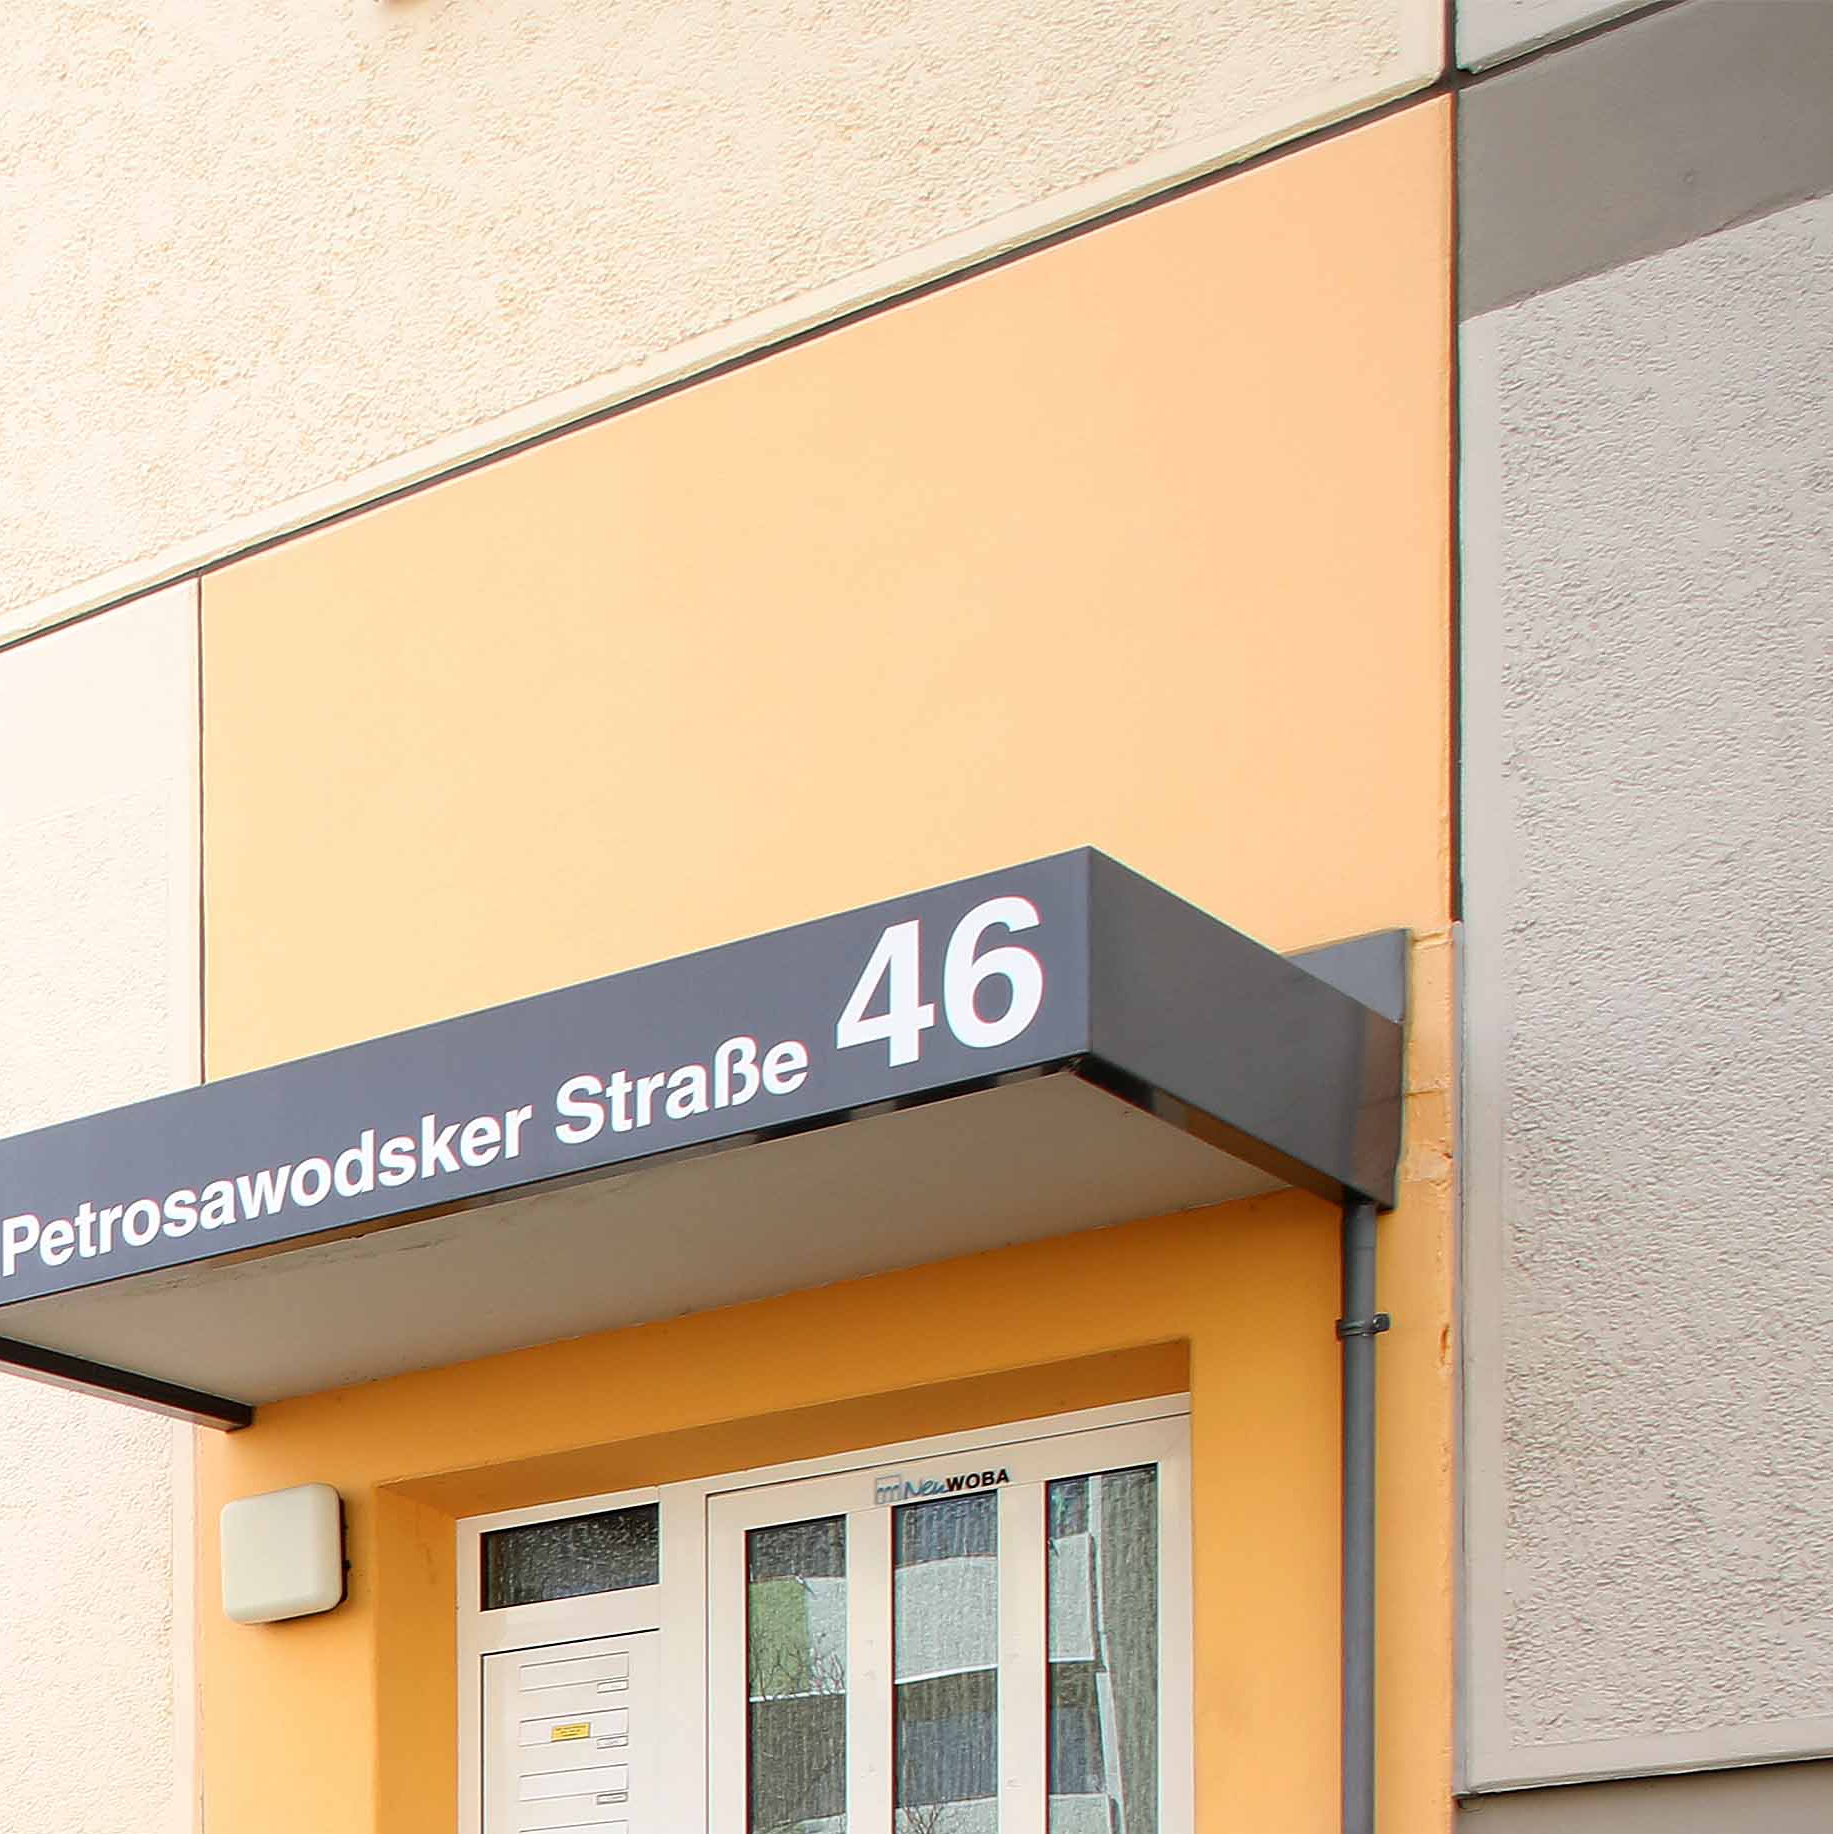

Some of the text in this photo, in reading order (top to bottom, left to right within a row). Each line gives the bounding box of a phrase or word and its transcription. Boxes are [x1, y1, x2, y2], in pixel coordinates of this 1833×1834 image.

[2, 895, 1046, 1277] Petrosawodsker Straße 46
